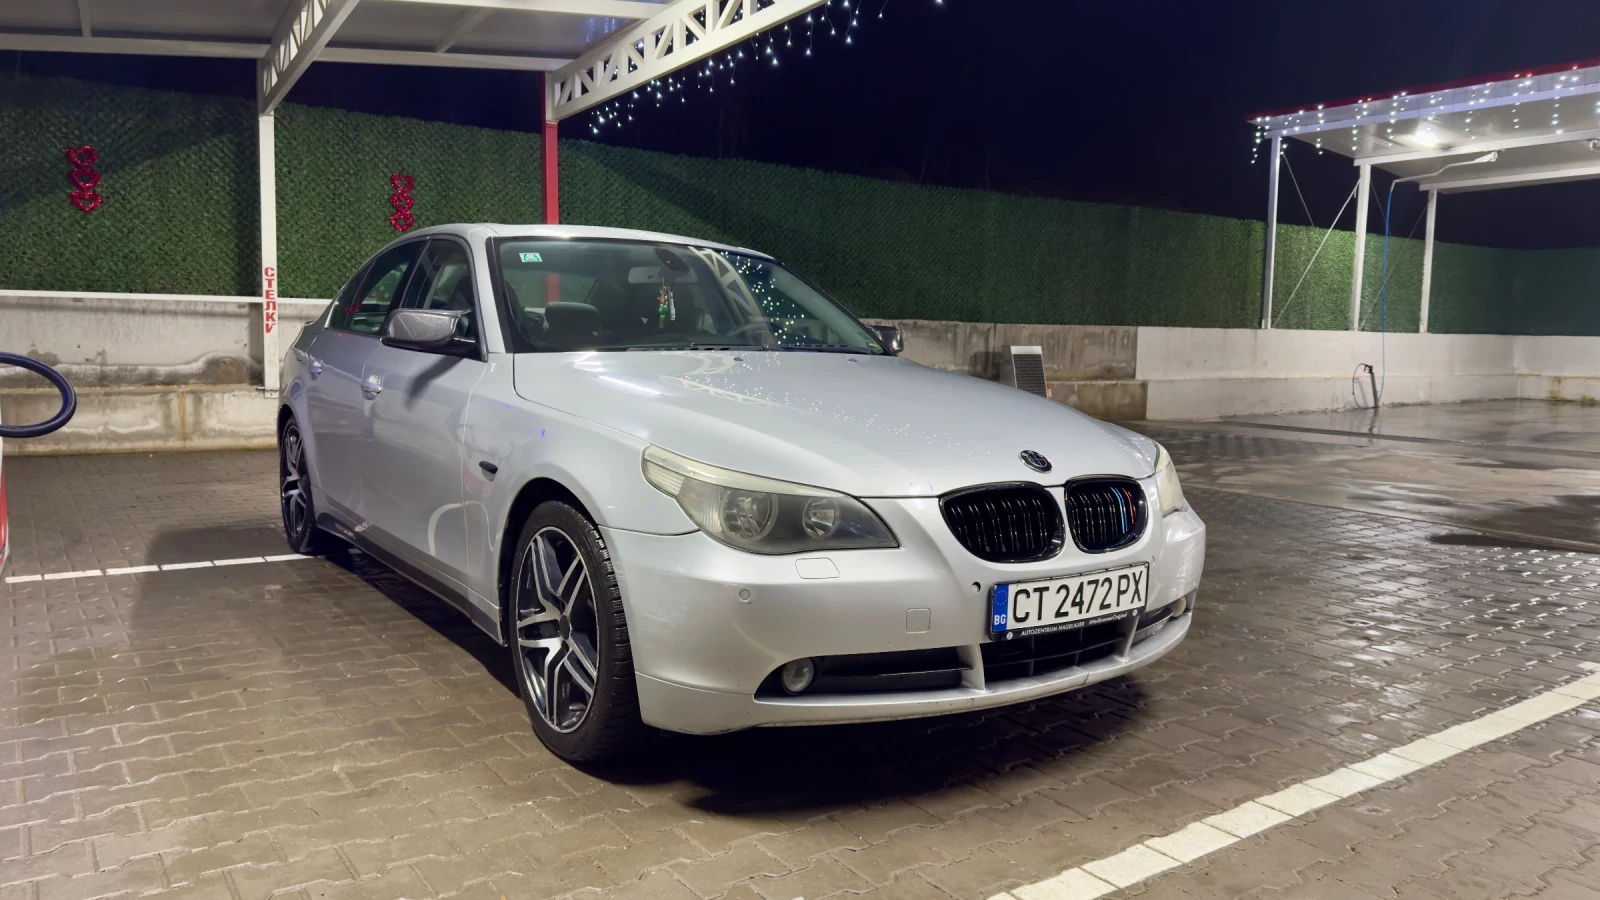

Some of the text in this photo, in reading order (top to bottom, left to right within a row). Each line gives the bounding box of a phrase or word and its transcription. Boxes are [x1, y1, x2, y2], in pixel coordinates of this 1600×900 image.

[1013, 570, 1143, 623] CT 2472 PX
[994, 614, 1006, 626] BG
[1020, 625, 1057, 636] AUTOZENTRUM
